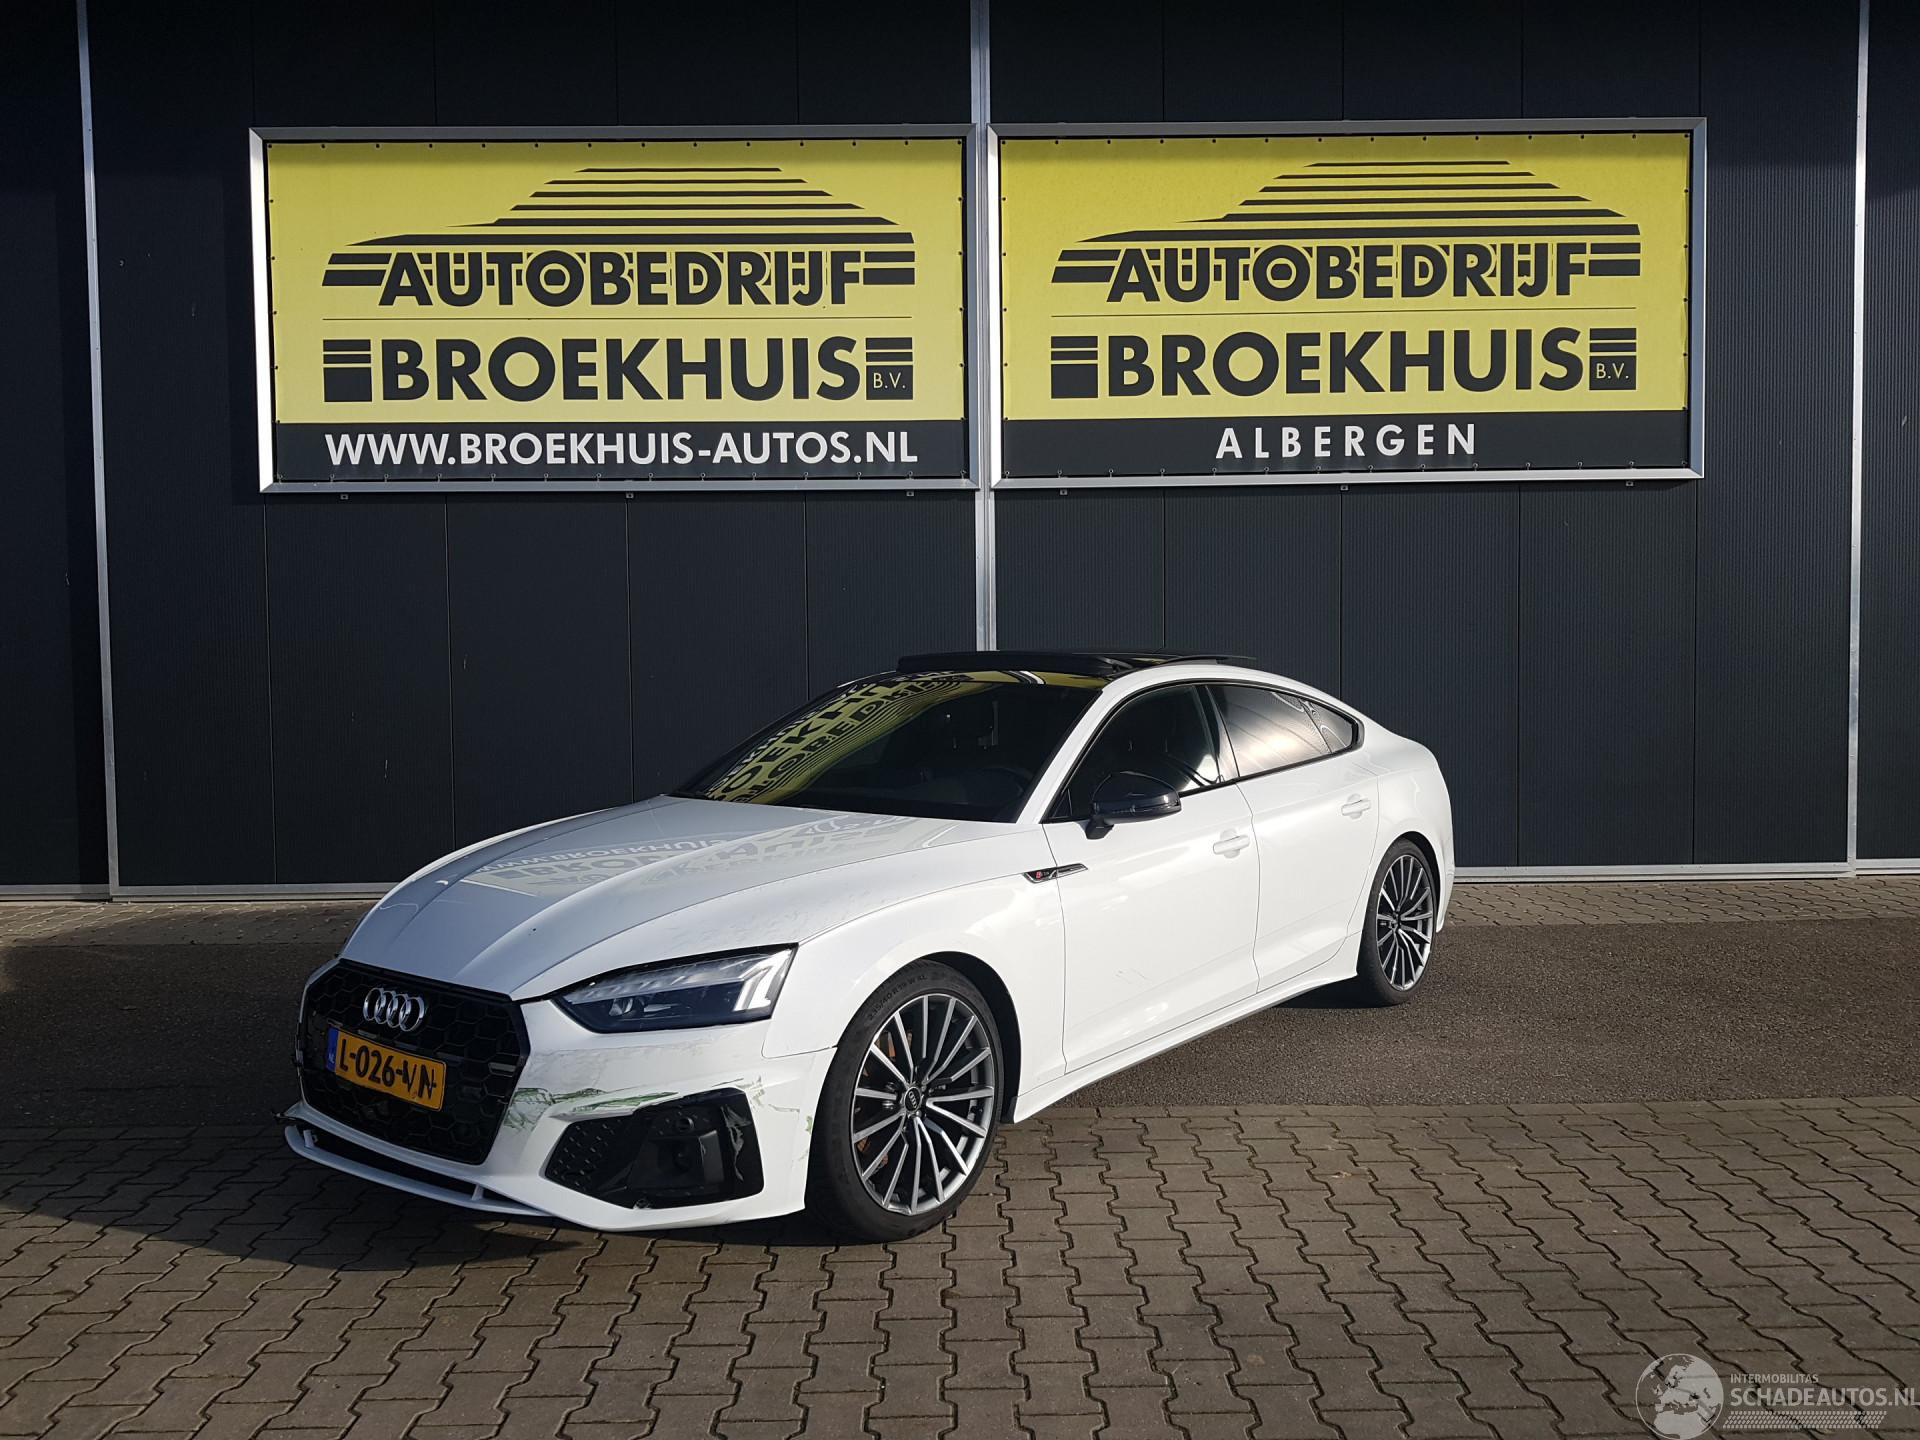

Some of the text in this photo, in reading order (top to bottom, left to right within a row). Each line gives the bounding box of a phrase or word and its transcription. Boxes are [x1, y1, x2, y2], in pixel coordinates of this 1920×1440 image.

[379, 249, 863, 306] AUTOBEDRIJF
[1106, 241, 1588, 303] AUTOBEDRIJF
[381, 335, 907, 401] BROEKHUIS B.V.
[1107, 326, 1630, 397] BROEKHUIS B.V.
[324, 430, 918, 465] WWW.BROEKHUIS-AUTOS.NL
[1215, 422, 1477, 460] ALBERGEN
